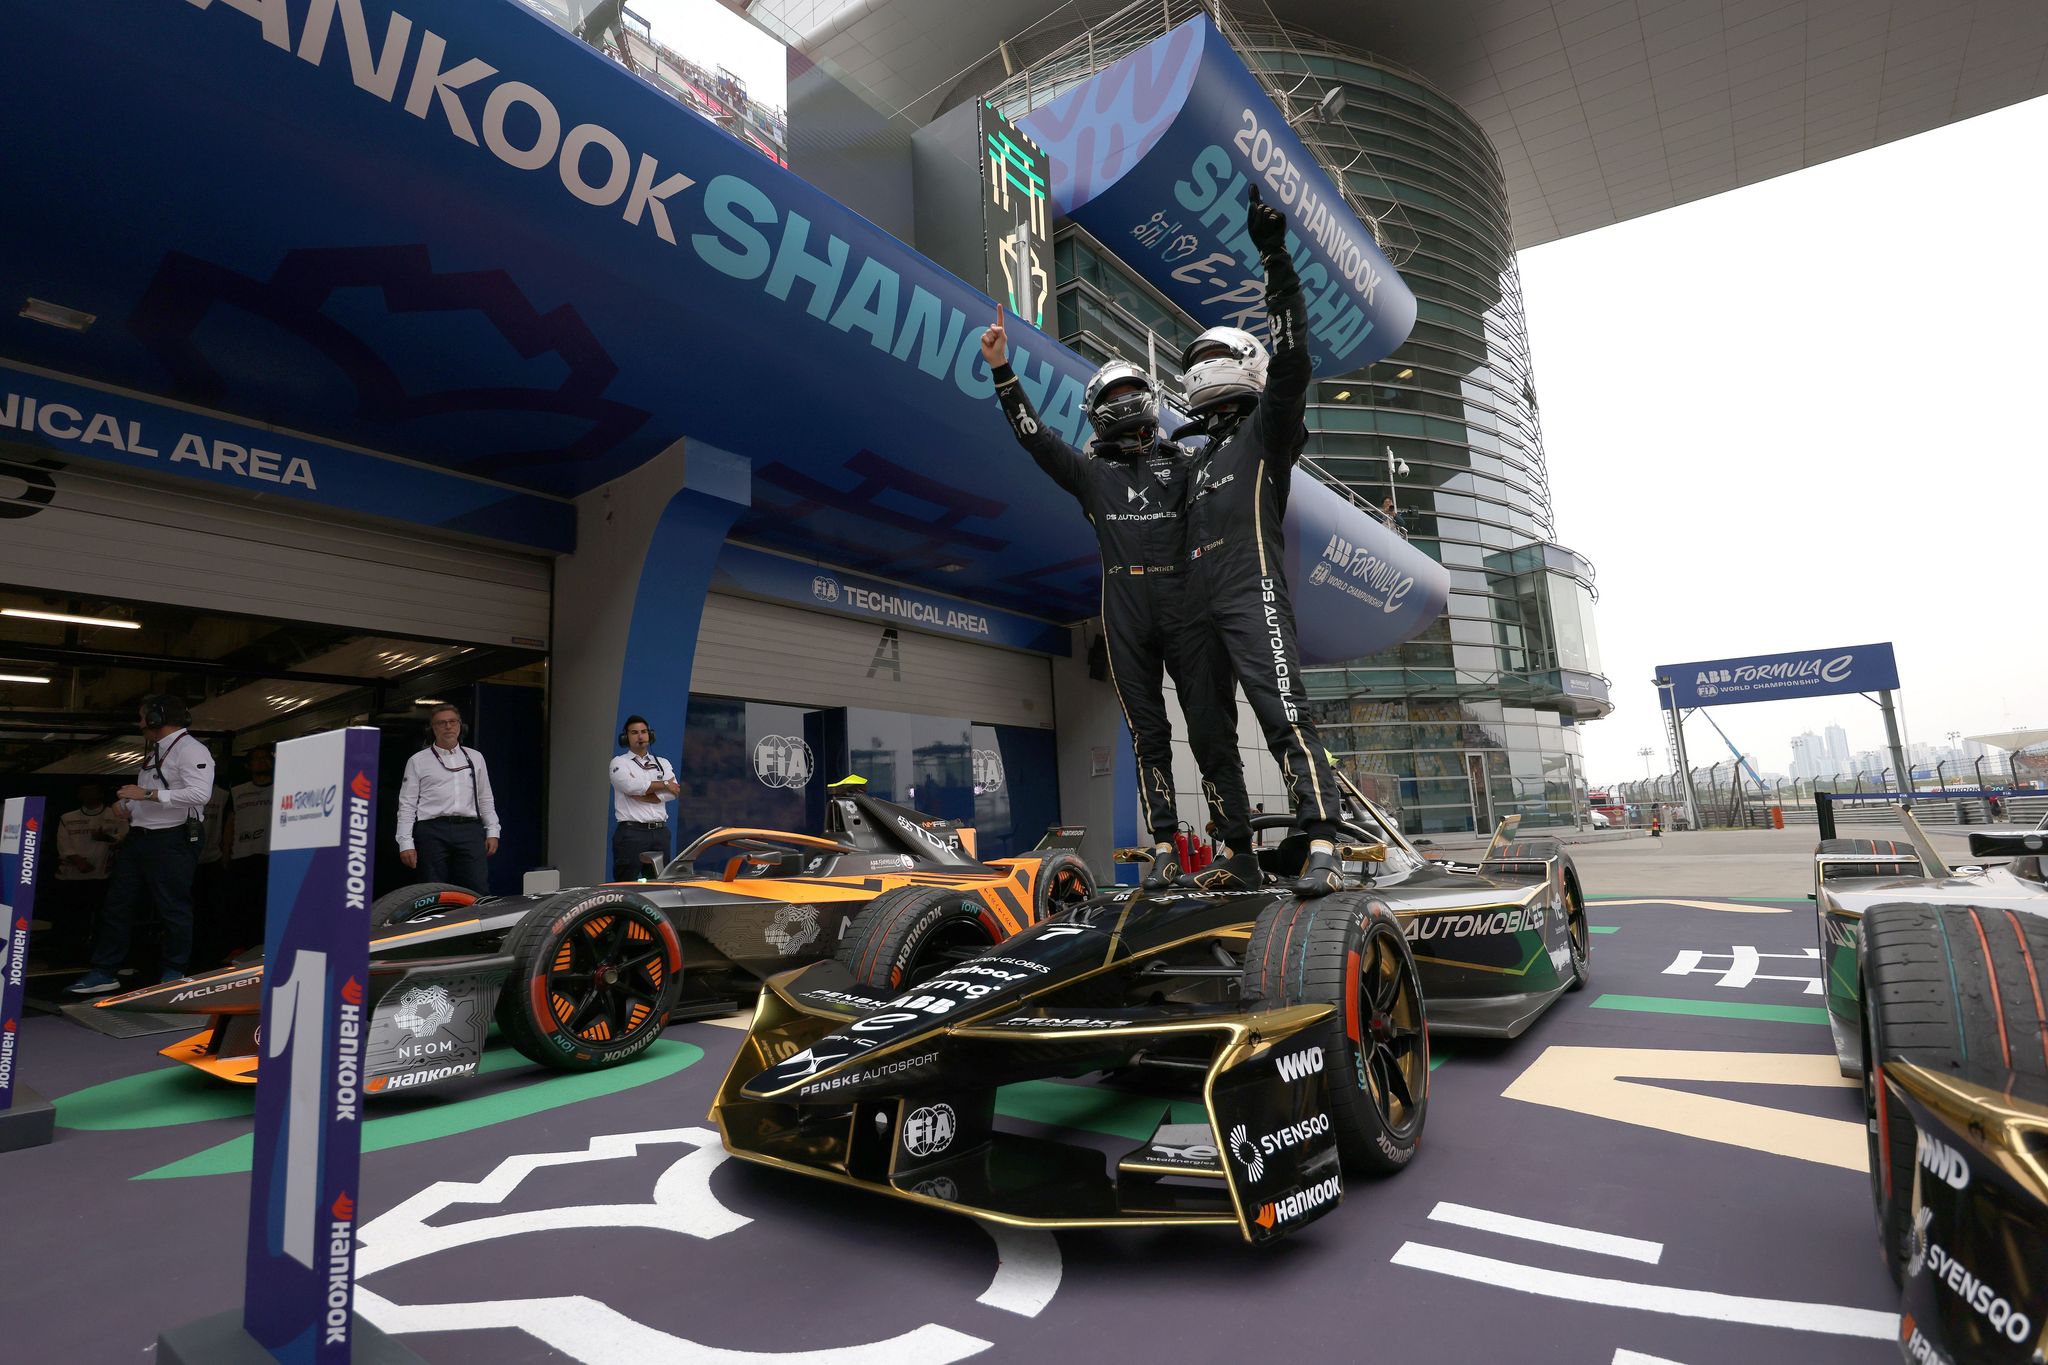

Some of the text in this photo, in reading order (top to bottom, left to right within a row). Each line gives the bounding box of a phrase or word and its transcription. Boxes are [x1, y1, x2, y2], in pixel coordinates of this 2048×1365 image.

[1234, 109, 1382, 306] 2025 HANKOOK
[170, 432, 317, 490] AREA
[1106, 511, 1177, 521] DS AUTOMOBILES
[1322, 534, 1353, 568] ABB
[1344, 548, 1399, 596] FORMULA
[844, 585, 944, 626] TECHNICAL
[946, 610, 989, 635] AREA
[1327, 574, 1347, 591] WORLD
[1347, 585, 1384, 608] CHAMPIONSHIP
[1261, 578, 1298, 723] DS AUTOMOBILES
[1696, 669, 1732, 685] ABB
[1734, 658, 1822, 683] FORMULA
[1720, 685, 1750, 693] WORLD
[1753, 678, 1820, 690] CHAMPIONSHIP
[908, 820, 961, 860] TDK
[1401, 903, 1544, 941] AUTOMOBILES
[1000, 957, 1051, 974] GLOBES
[811, 989, 888, 1007] PENSK
[879, 995, 956, 1014] ABB
[398, 1040, 452, 1059] NEOM
[1275, 1046, 1325, 1083] WWD
[800, 1052, 940, 1097] PENSKE AUTOSPORT
[269, 949, 327, 1270] 1
[1260, 1113, 1330, 1155] SYENSQO
[1145, 1156, 1216, 1166] TotalEnergies
[1927, 1243, 2031, 1344] SYENSQO
